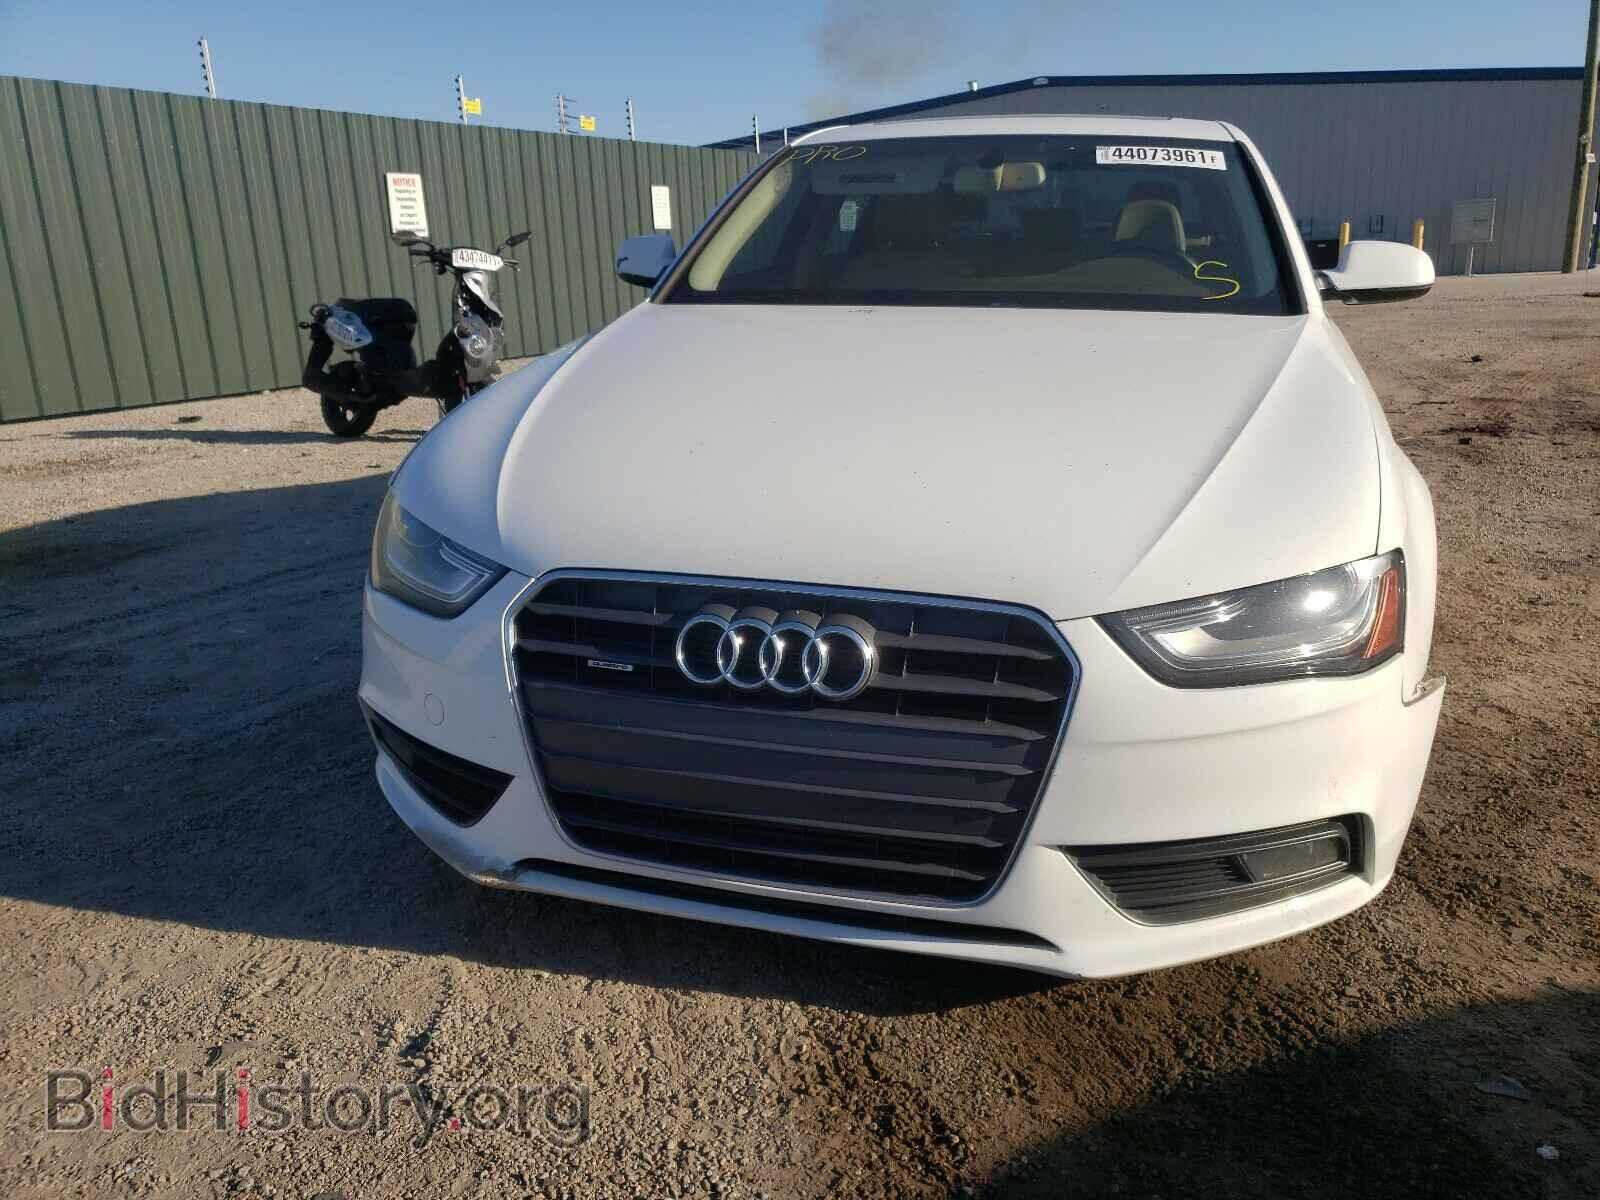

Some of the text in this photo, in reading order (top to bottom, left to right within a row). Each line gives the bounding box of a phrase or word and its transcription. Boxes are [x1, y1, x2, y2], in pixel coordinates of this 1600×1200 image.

[1112, 147, 1206, 164] 44073961
[392, 177, 417, 188] NOTICE
[1194, 260, 1240, 300] S
